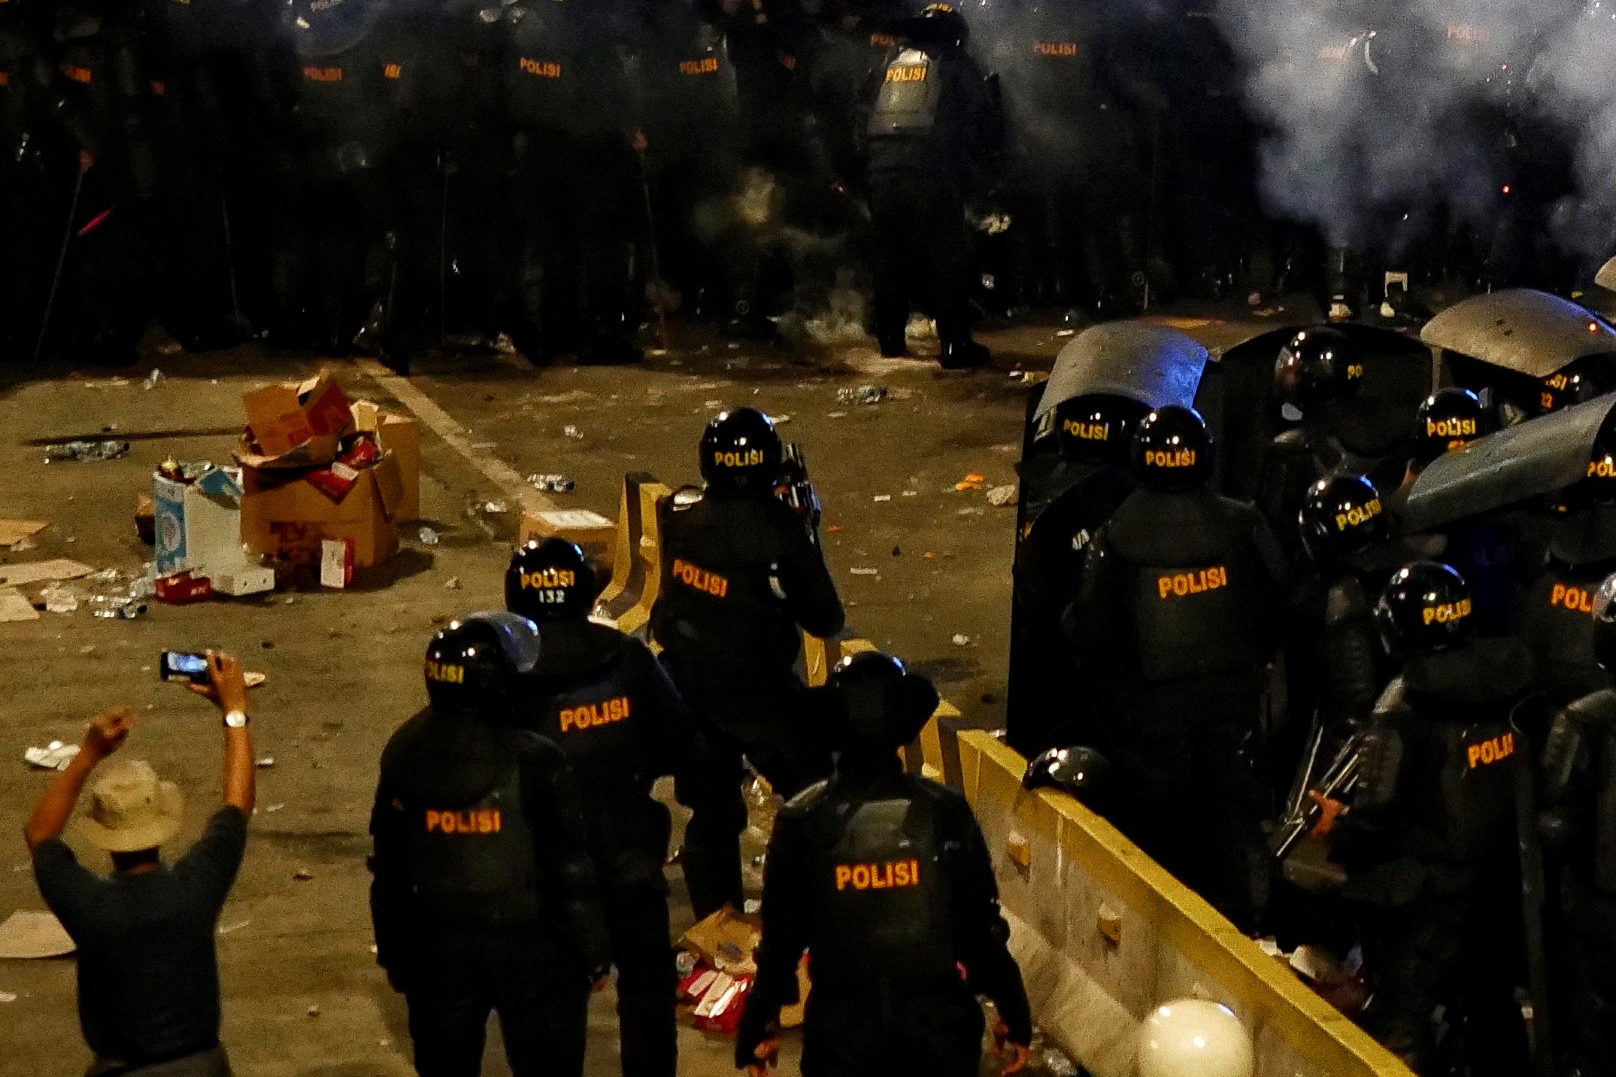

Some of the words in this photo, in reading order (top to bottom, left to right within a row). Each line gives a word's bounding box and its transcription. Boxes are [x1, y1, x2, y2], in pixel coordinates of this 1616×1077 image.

[519, 57, 561, 78] POLISI
[679, 57, 719, 74] POLISI
[886, 67, 928, 82] POLISI
[1063, 418, 1109, 440] POLISI
[1427, 418, 1476, 437] POLISI
[715, 450, 764, 468] POLISI
[1144, 450, 1196, 467] POLISI
[520, 570, 575, 589] POLISI
[673, 558, 728, 598] POLISI
[1158, 566, 1228, 599] POLISI
[539, 590, 564, 603] 132
[1423, 598, 1472, 625] POLISI
[559, 696, 630, 732] POLISI
[426, 809, 501, 832] POLISI
[835, 860, 919, 891] POLISI
